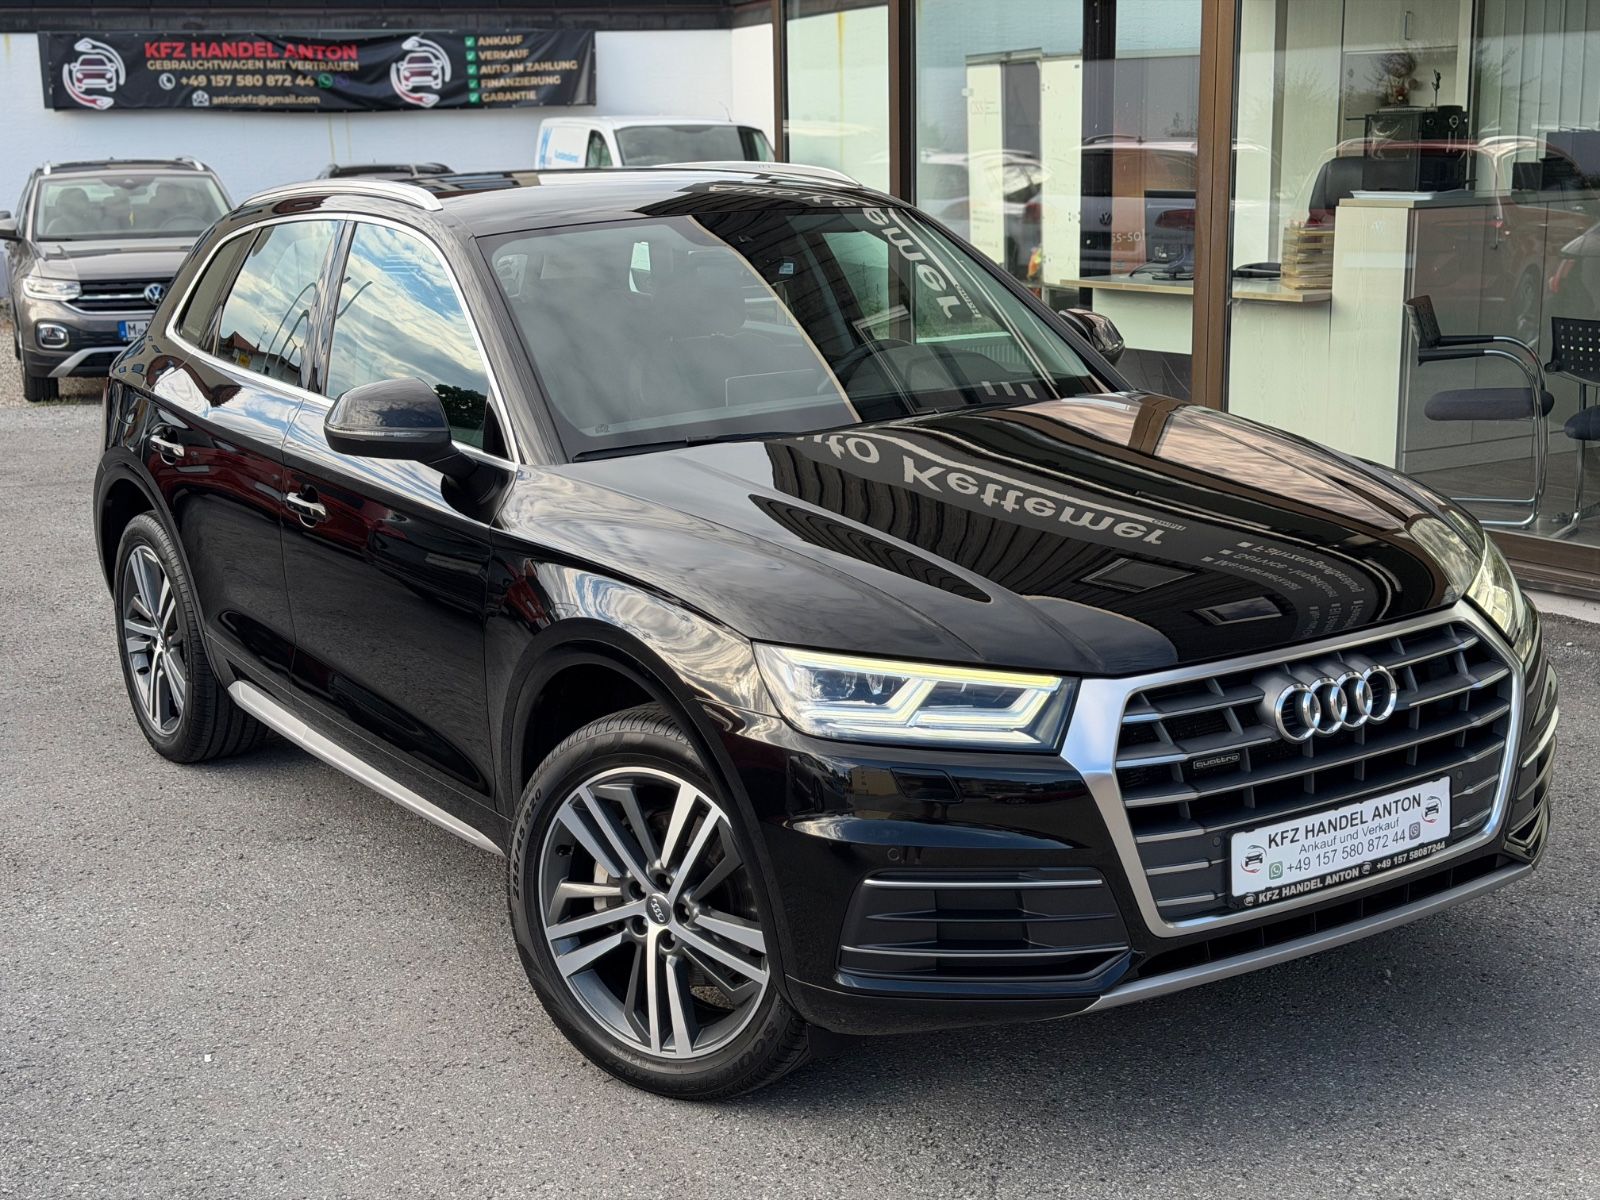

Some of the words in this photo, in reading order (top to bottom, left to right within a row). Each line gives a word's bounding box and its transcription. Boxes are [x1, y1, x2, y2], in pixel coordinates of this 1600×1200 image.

[477, 35, 523, 46] ANKAUF
[144, 42, 186, 58] KFZ
[192, 42, 279, 58] HANDEL
[284, 43, 358, 60] ANTON
[479, 49, 529, 60] VERKAUF
[147, 60, 264, 70] GEBRAUCHTWAGEN
[266, 60, 287, 70] MIT
[290, 61, 359, 71] VERTRAUEN
[480, 63, 510, 75] AUTO
[525, 60, 578, 72] ZAHLUNG
[180, 75, 207, 87] +49
[210, 75, 233, 87] 157
[236, 75, 263, 87] 580
[266, 75, 292, 87] 872
[295, 75, 315, 87] 44
[481, 75, 561, 88] FINANZIERUNG
[482, 91, 536, 103] GARANTIE
[1196, 755, 1238, 768] quattro
[1268, 827, 1299, 849] KFZ
[1305, 811, 1368, 840] HANDEL
[1371, 793, 1422, 822] ANTON
[1299, 834, 1337, 855] Ankauf
[1340, 829, 1359, 844] und
[1362, 818, 1400, 837] Verkauf
[1286, 856, 1310, 873] +49
[1316, 849, 1337, 868] 157
[1341, 842, 1364, 860] 580
[1367, 834, 1389, 852] 872
[1392, 829, 1406, 845] 44
[1258, 890, 1280, 903] KFZ
[1282, 878, 1323, 898] HANDEL
[1325, 868, 1359, 886] ANTON
[1376, 858, 1392, 870] +49
[1393, 854, 1405, 866] 157
